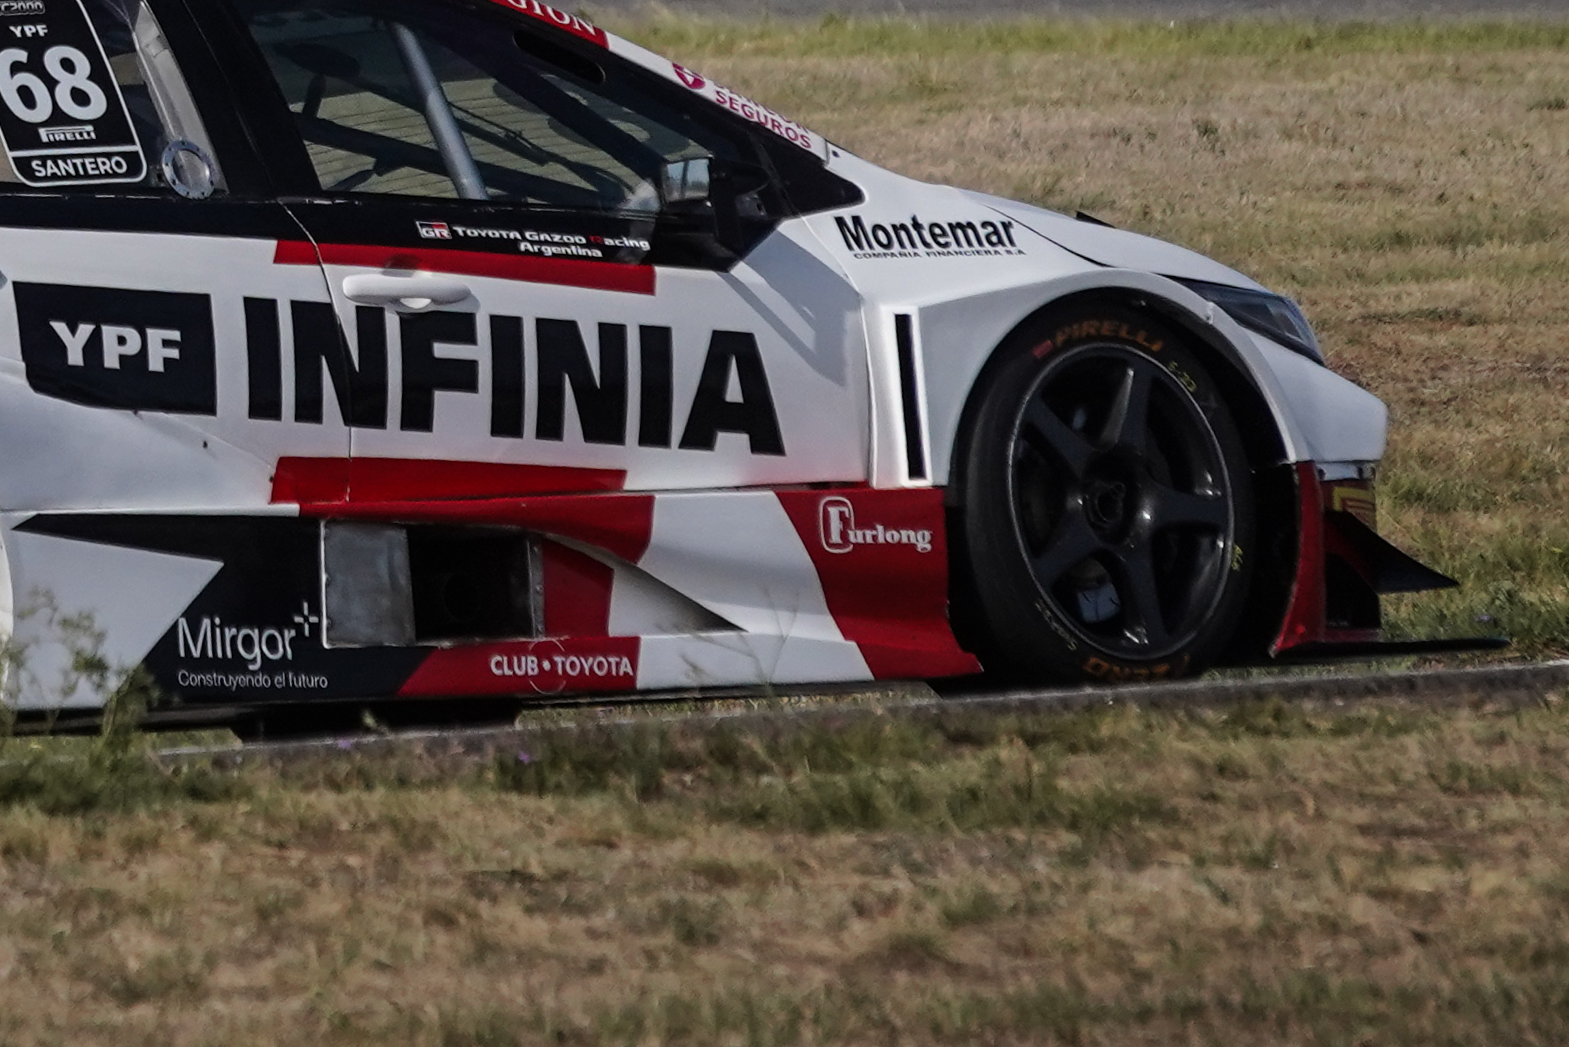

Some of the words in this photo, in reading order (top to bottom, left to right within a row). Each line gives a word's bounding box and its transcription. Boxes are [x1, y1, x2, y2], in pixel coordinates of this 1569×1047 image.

[9, 25, 49, 38] YPF
[38, 125, 96, 143] PIRELLI
[715, 90, 812, 149] SEGUROS
[31, 156, 128, 178] SANTERO
[519, 241, 603, 258] Argentina
[833, 213, 1014, 252] Montemar
[49, 320, 182, 373] YPF
[1055, 318, 1164, 353] PIRELLI
[243, 296, 787, 457] INFINIA
[827, 506, 933, 553] Furlong
[178, 616, 296, 671] Mirgor
[178, 670, 271, 691] Construyendo
[274, 672, 286, 687] el
[490, 655, 539, 676] CLUB
[554, 656, 634, 676] TOYOTA
